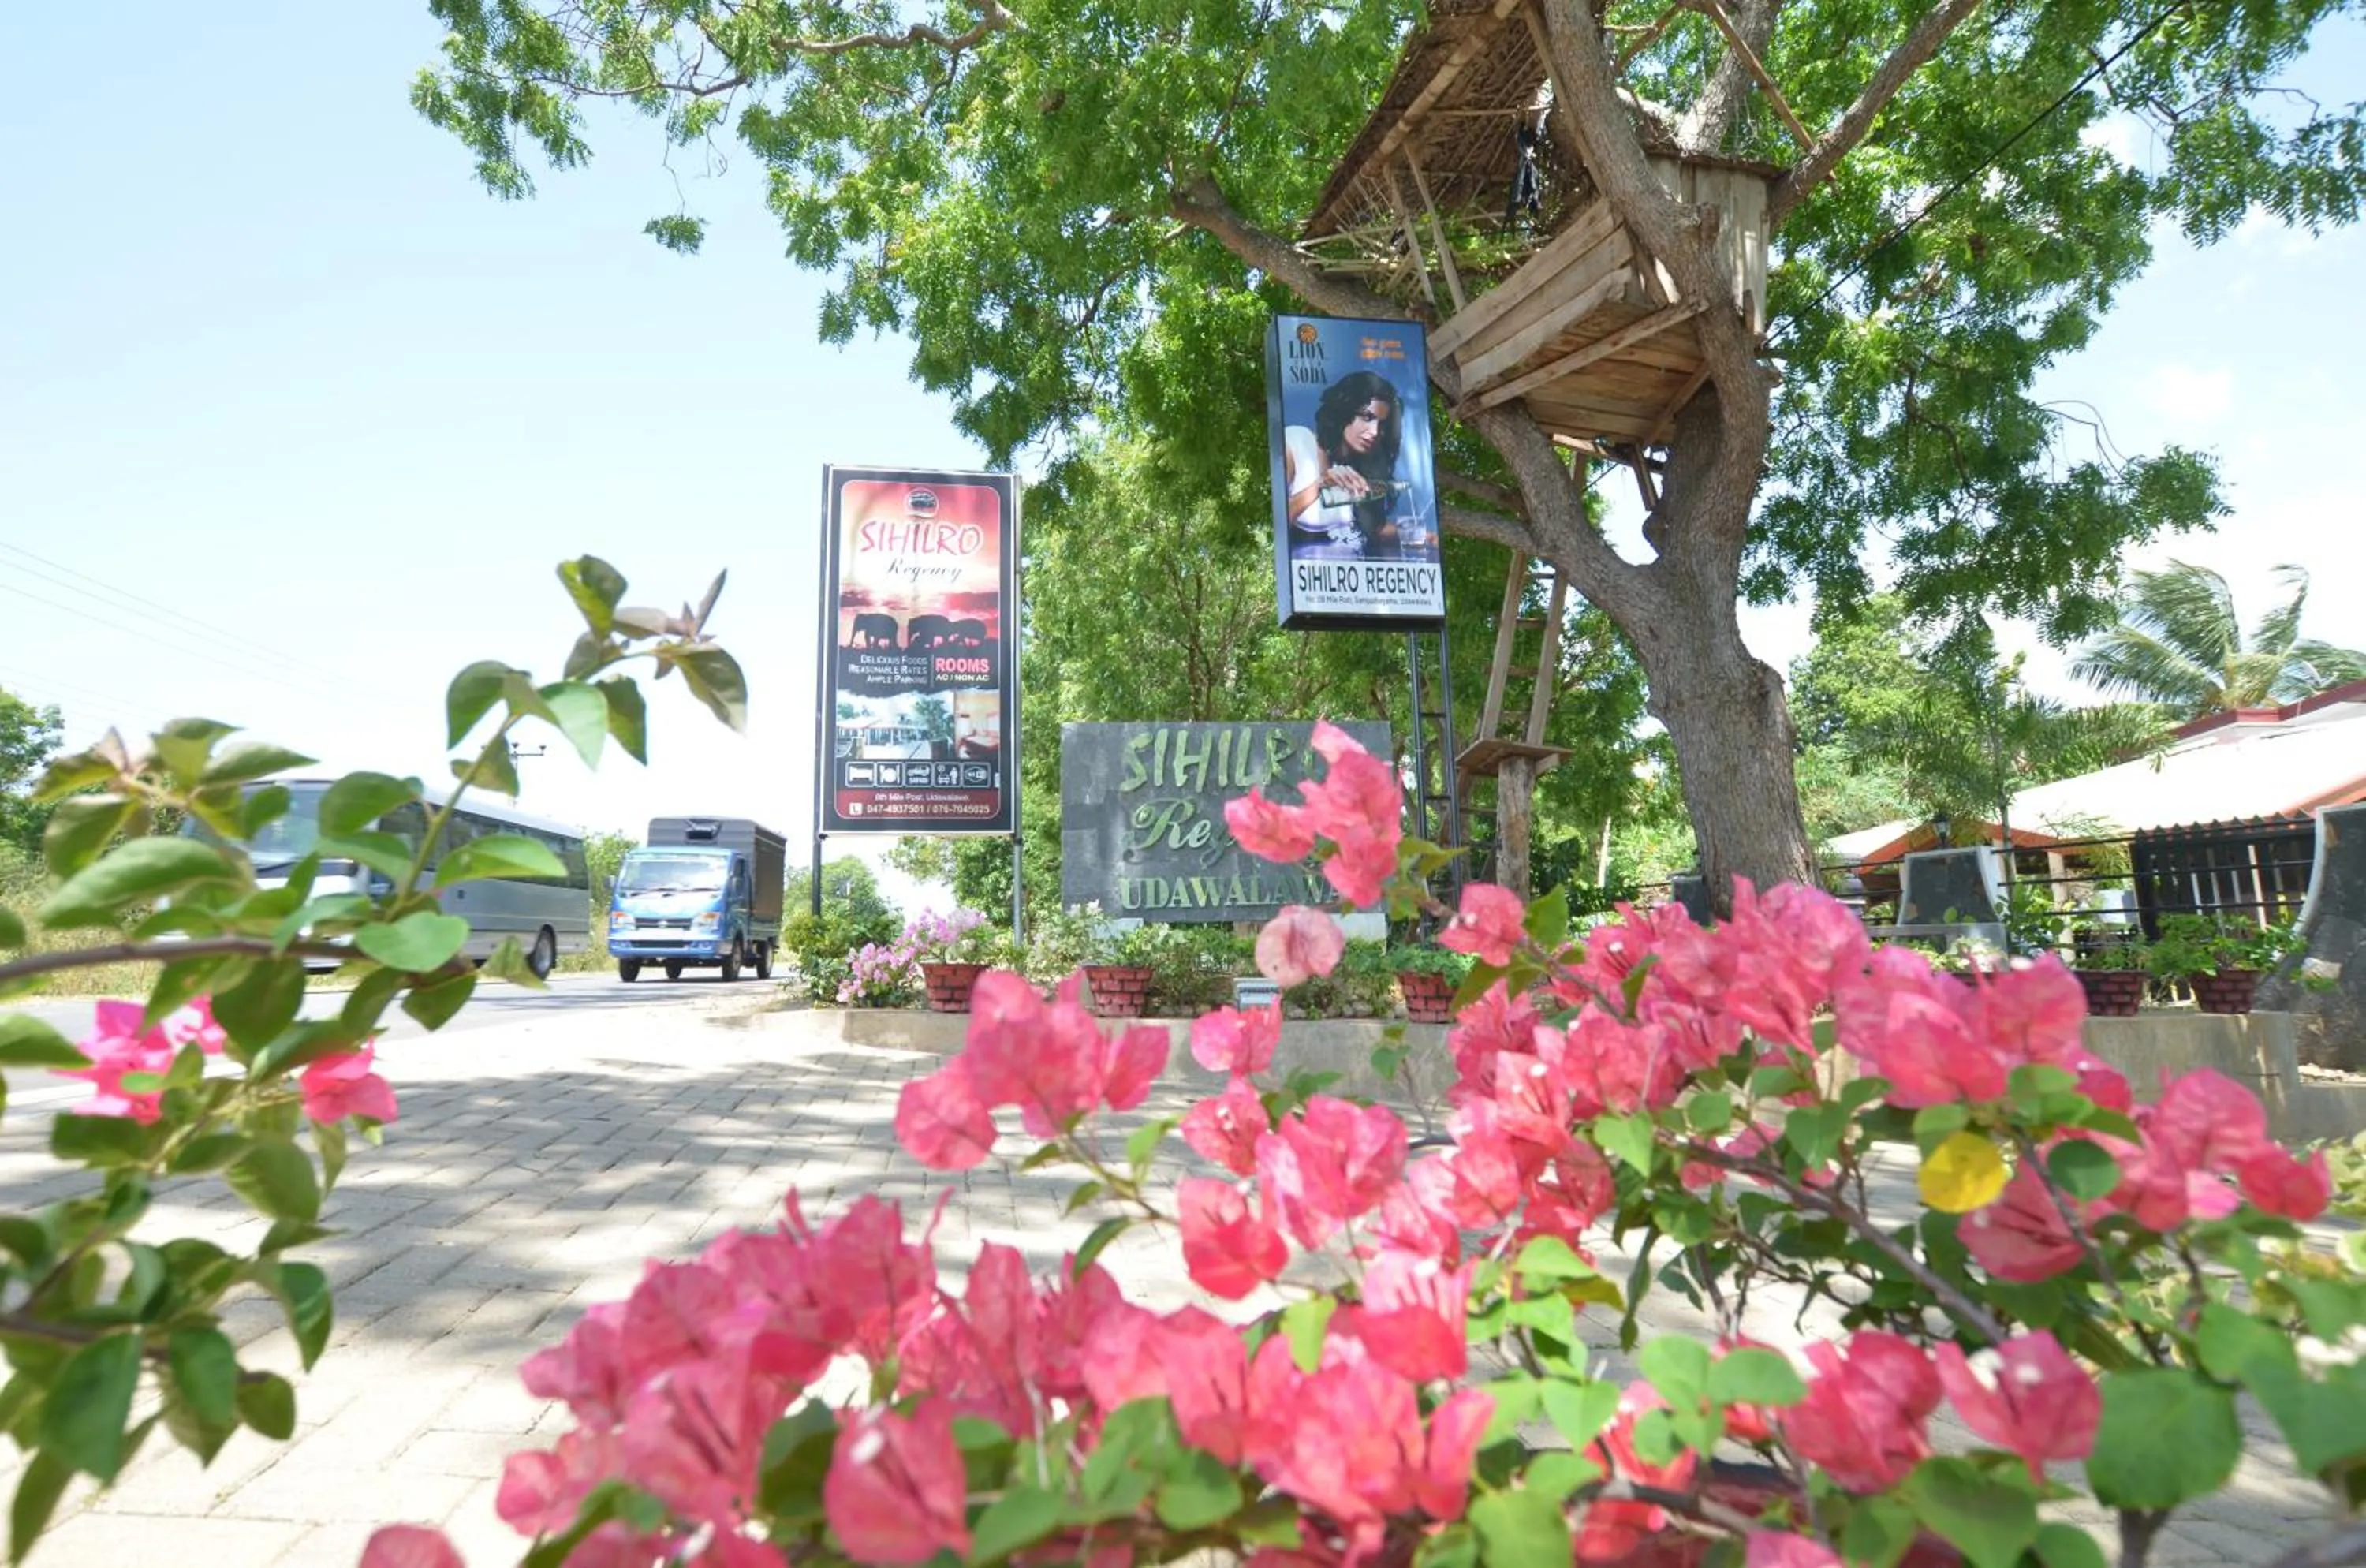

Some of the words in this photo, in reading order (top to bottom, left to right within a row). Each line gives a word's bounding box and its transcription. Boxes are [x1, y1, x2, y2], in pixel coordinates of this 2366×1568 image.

[1289, 340, 1326, 360] LION
[1289, 365, 1327, 384] SODA
[860, 521, 981, 555] SIHILRO
[885, 558, 963, 583] Regency
[1298, 565, 1359, 592] SIHILRO
[1365, 567, 1436, 595] REGENCY
[935, 657, 990, 673] ROOMS
[1120, 727, 1315, 793] SIHILR
